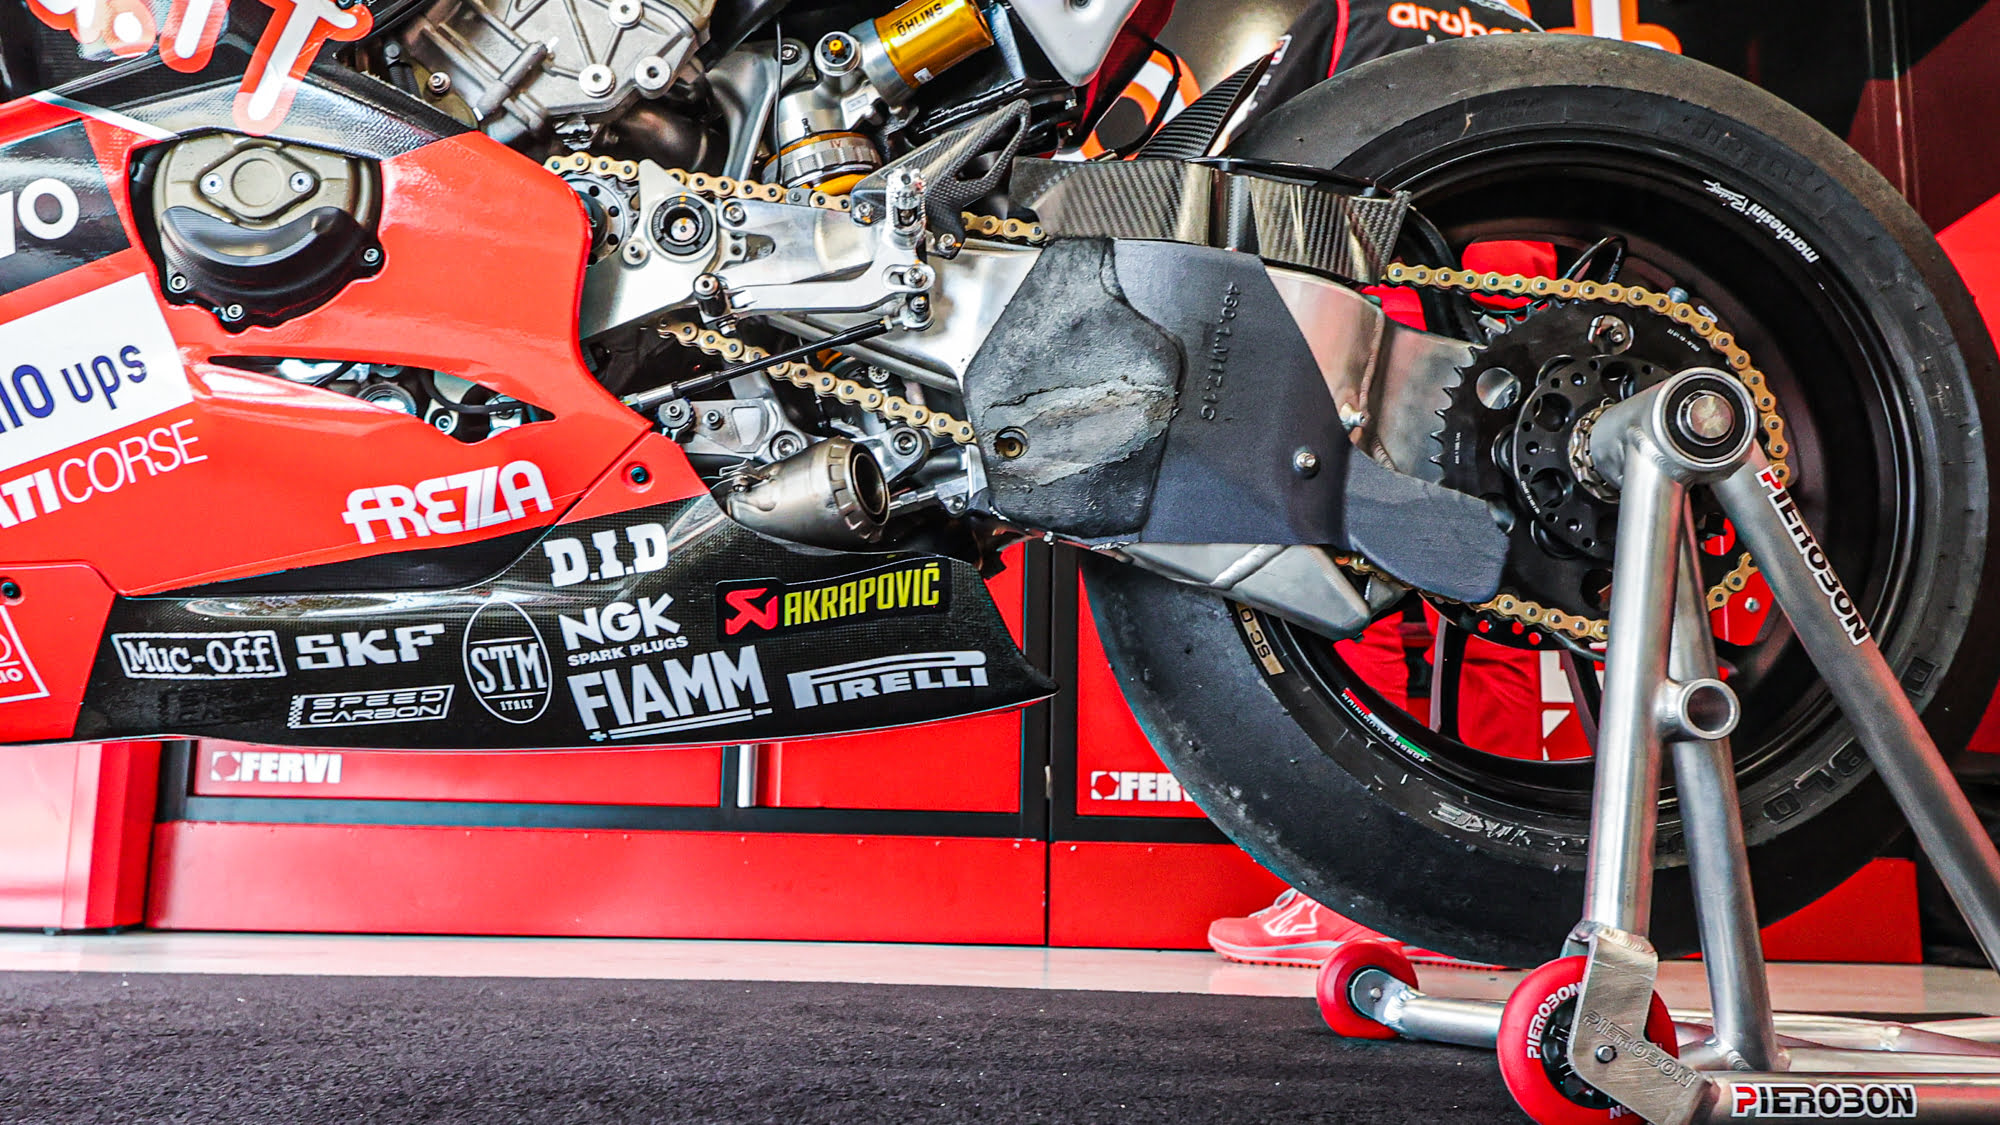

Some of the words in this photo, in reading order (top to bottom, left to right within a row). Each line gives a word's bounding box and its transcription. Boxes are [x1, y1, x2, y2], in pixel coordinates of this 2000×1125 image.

[1387, 2, 1513, 37] arub
[1744, 203, 1820, 263] marchesini
[60, 344, 148, 411] ups
[57, 418, 209, 504] CORSE
[543, 523, 669, 588] D.I.D
[1755, 465, 1871, 646] PIEROBON
[558, 592, 681, 651] NGK
[122, 636, 276, 674] Muc-Off
[295, 623, 446, 671] SKF
[470, 642, 548, 694] STM
[567, 646, 627, 667] SPARK
[630, 636, 689, 657] PLUGS
[312, 689, 445, 710] SPEED
[500, 698, 534, 711] ITALY
[566, 645, 770, 731] FIAMM
[787, 650, 989, 710] PIRELLI
[309, 704, 443, 724] CARBON
[239, 752, 343, 784] FERVI
[1120, 772, 1195, 802] FER
[1583, 1009, 1698, 1089] PIEROBON
[1731, 1082, 1918, 1117] PIEROBON
